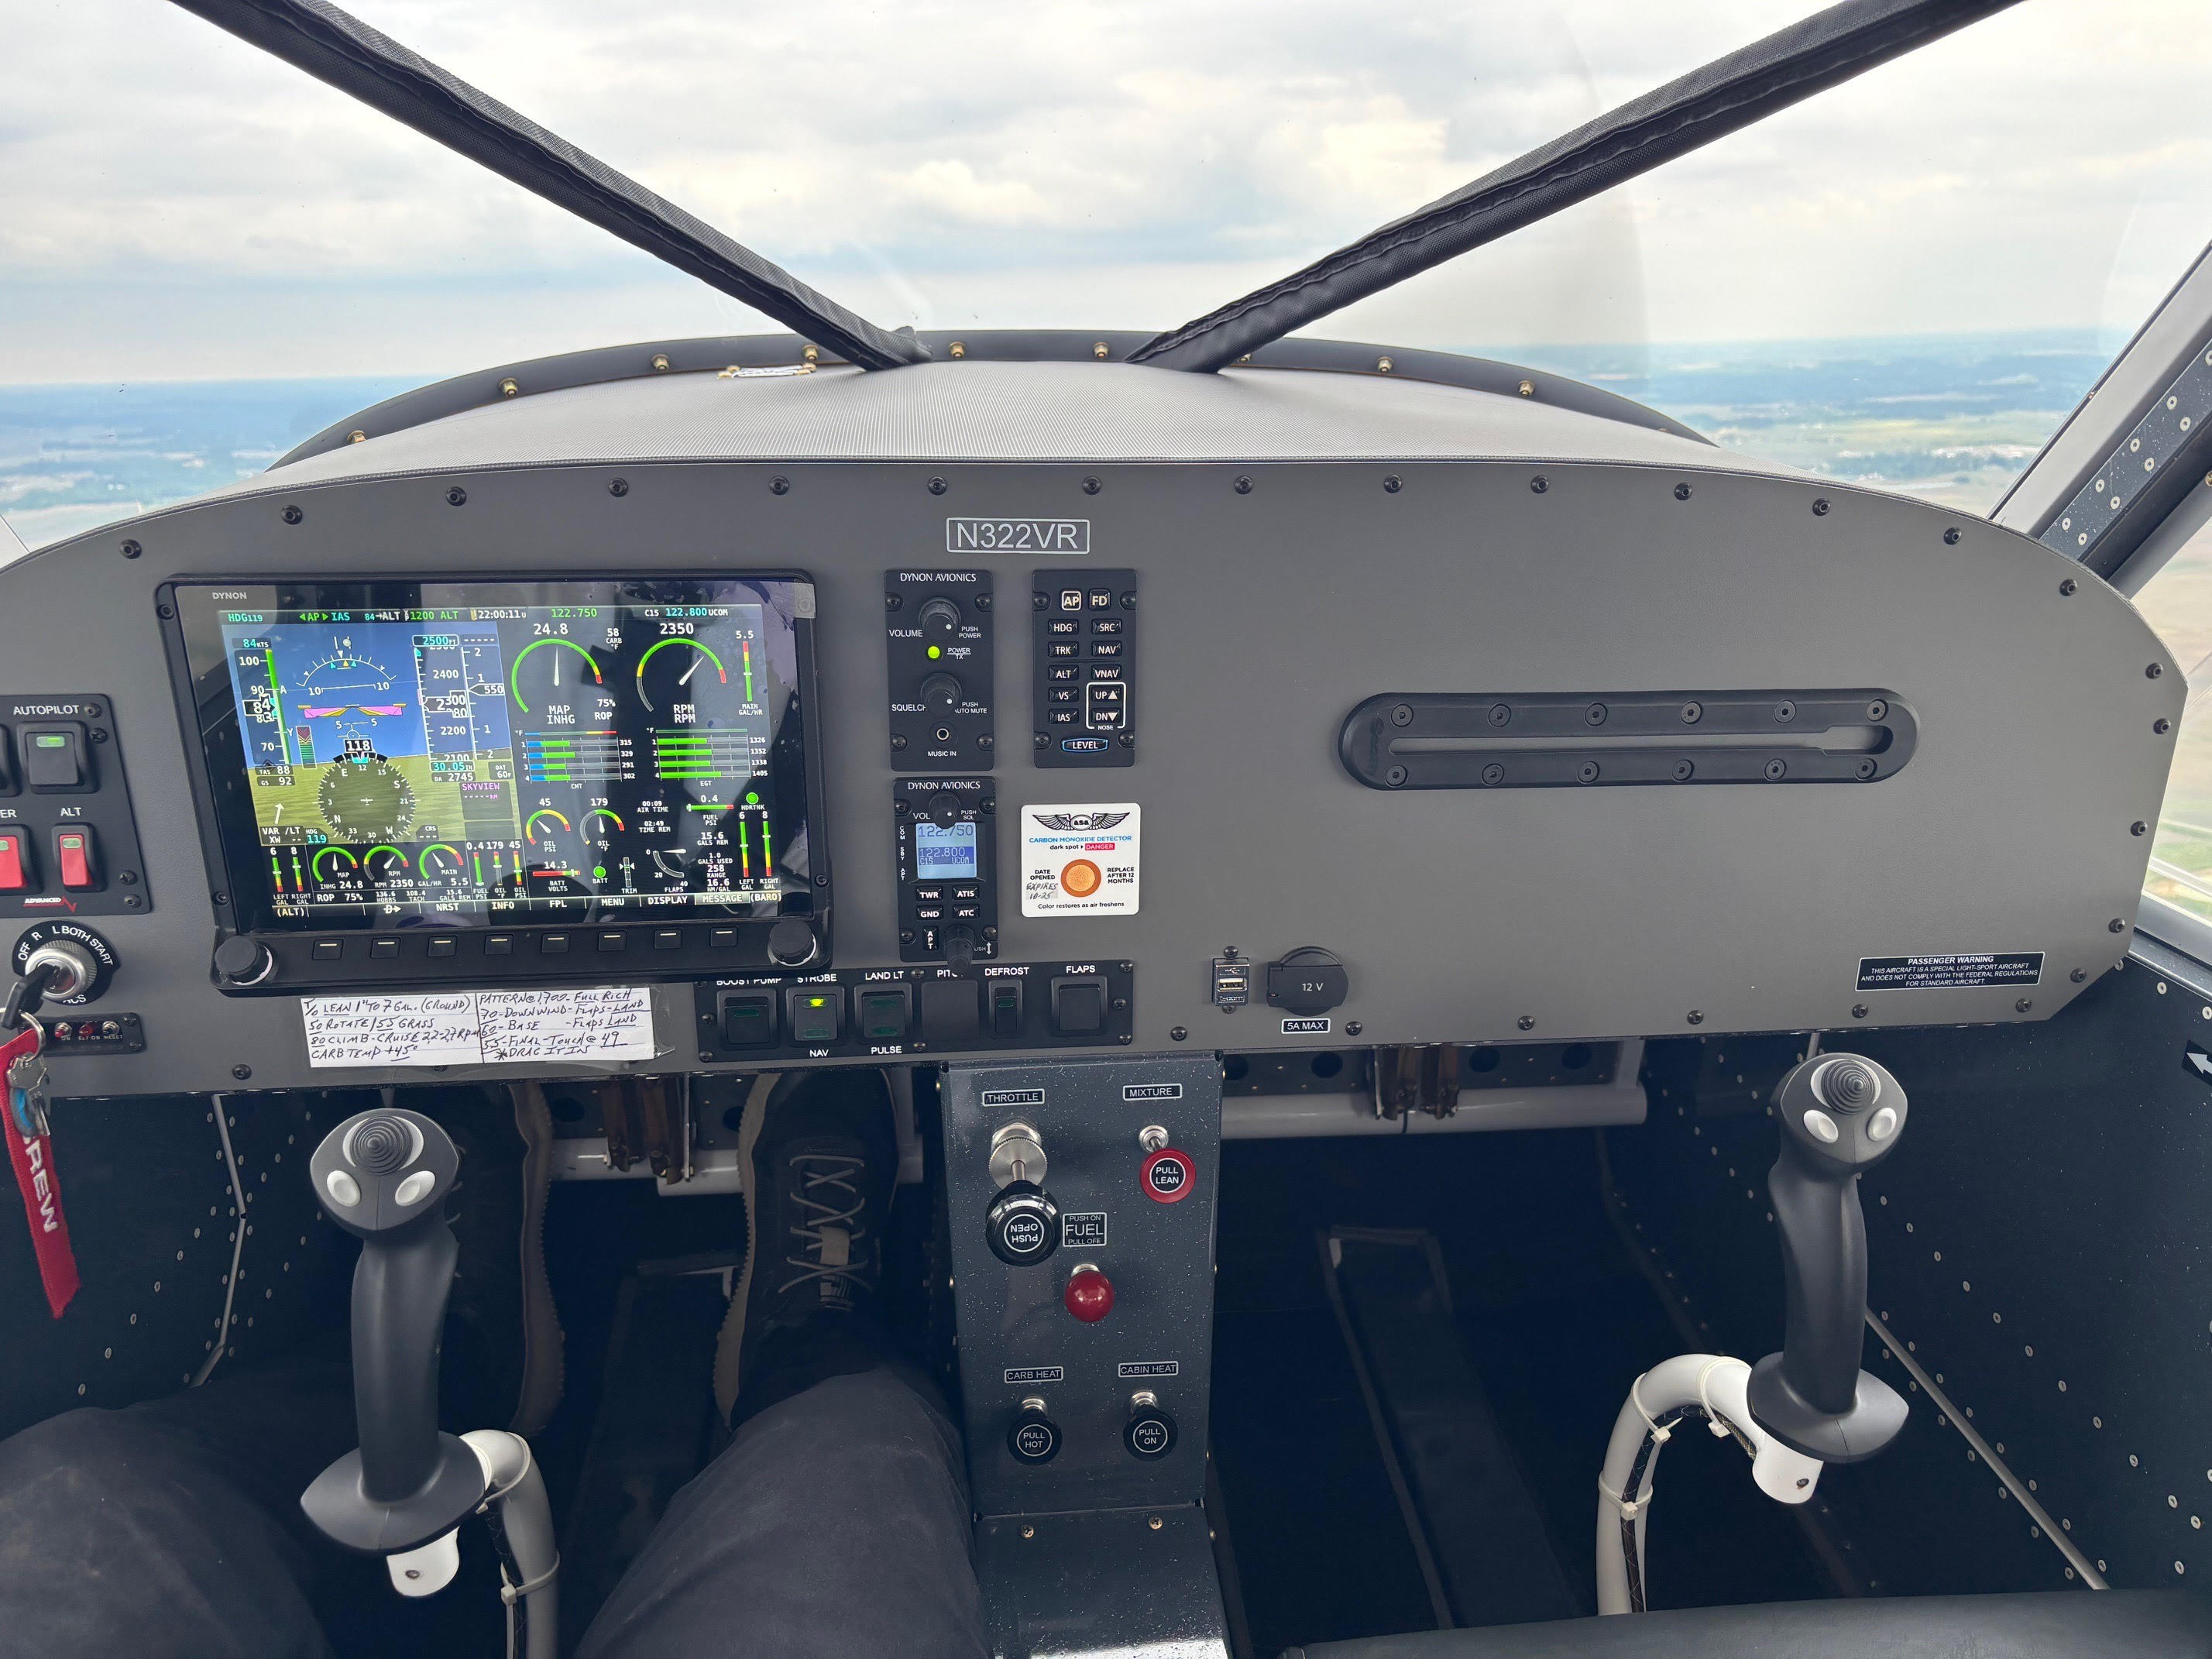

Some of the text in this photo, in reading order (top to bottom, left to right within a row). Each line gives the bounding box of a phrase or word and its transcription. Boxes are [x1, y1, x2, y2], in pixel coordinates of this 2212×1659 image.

[957, 523, 1078, 548] N322VR
[1064, 596, 1107, 606] AP FD
[331, 613, 350, 621] IAS
[410, 611, 459, 620] 1200 ALT
[551, 609, 597, 618] 122.750
[534, 623, 568, 635] 24.8
[660, 623, 693, 634] 2350
[1054, 623, 1115, 632] HDG SRC
[736, 630, 754, 639] 5.5
[1056, 646, 1070, 654] TRK
[239, 657, 259, 665] 100
[433, 670, 459, 678] 2400
[13, 706, 79, 714] AUTOPILOT
[548, 706, 570, 714] MAP
[674, 704, 695, 713] RPM
[547, 712, 613, 724] INHG ROP
[675, 713, 696, 723] RPM
[441, 726, 465, 735] 2200
[347, 740, 370, 750] 118
[448, 773, 473, 781] 2745
[60, 807, 81, 816] ALT
[307, 835, 327, 843] 119
[919, 847, 965, 857] 122.800
[648, 896, 688, 905] DISPLAY
[18, 926, 113, 966] OFF BOTH START
[984, 967, 1029, 976] DEFROST
[1066, 965, 1095, 974] FLAPS
[865, 971, 891, 981] LAND
[1287, 1022, 1300, 1030] 5A
[312, 1049, 343, 1059] CARB
[871, 1046, 902, 1054] PULSE
[1129, 1087, 1172, 1097] MIXTURE
[988, 1093, 1039, 1102] THROTTLE
[1066, 1224, 1104, 1236] FUEL
[1012, 1234, 1038, 1242] PUSH
[1121, 1365, 1149, 1375] CABIN
